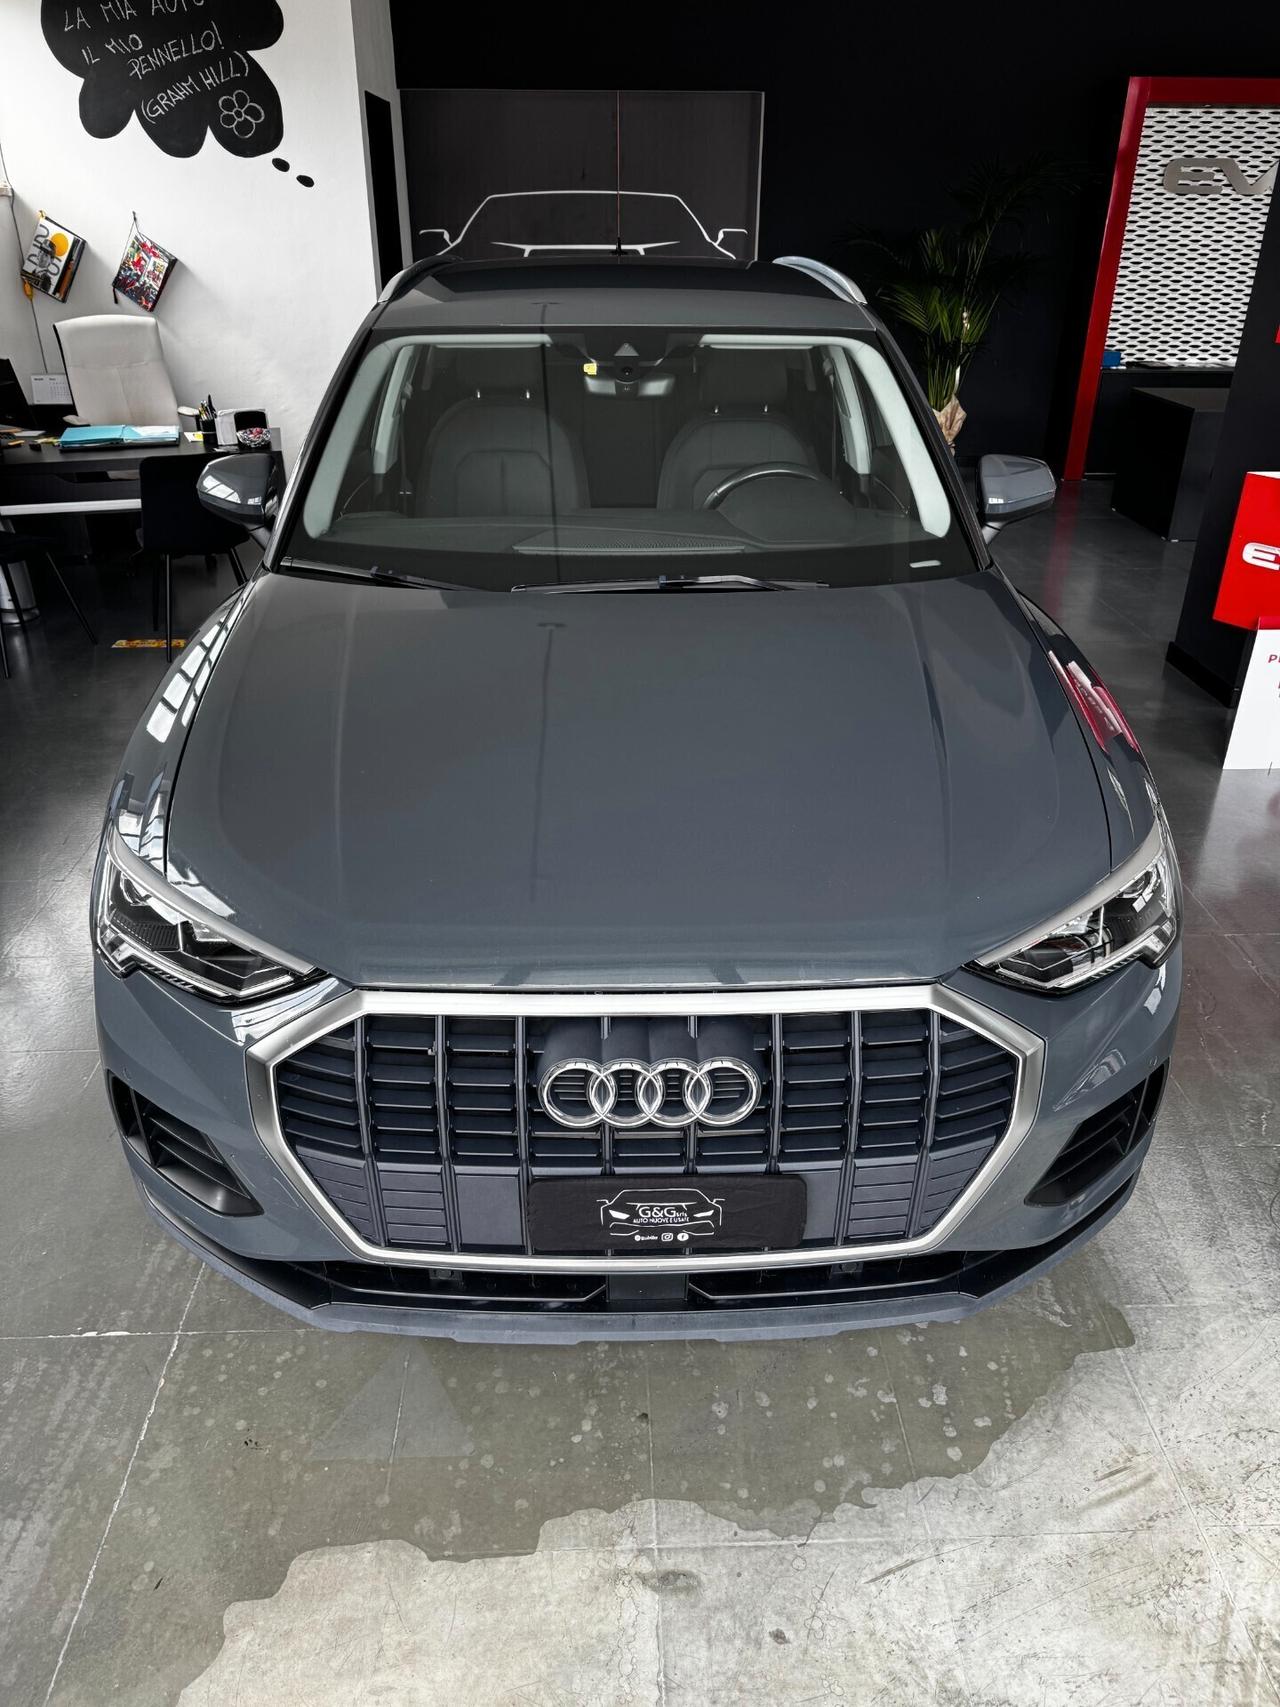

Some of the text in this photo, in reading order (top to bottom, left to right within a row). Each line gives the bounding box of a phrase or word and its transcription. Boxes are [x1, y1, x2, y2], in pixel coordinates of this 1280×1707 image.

[64, 7, 91, 32] LA
[100, 0, 137, 23] MIA
[82, 34, 143, 65] IL MIO
[127, 20, 224, 80] PENNELLO!
[199, 51, 248, 90] HILL)
